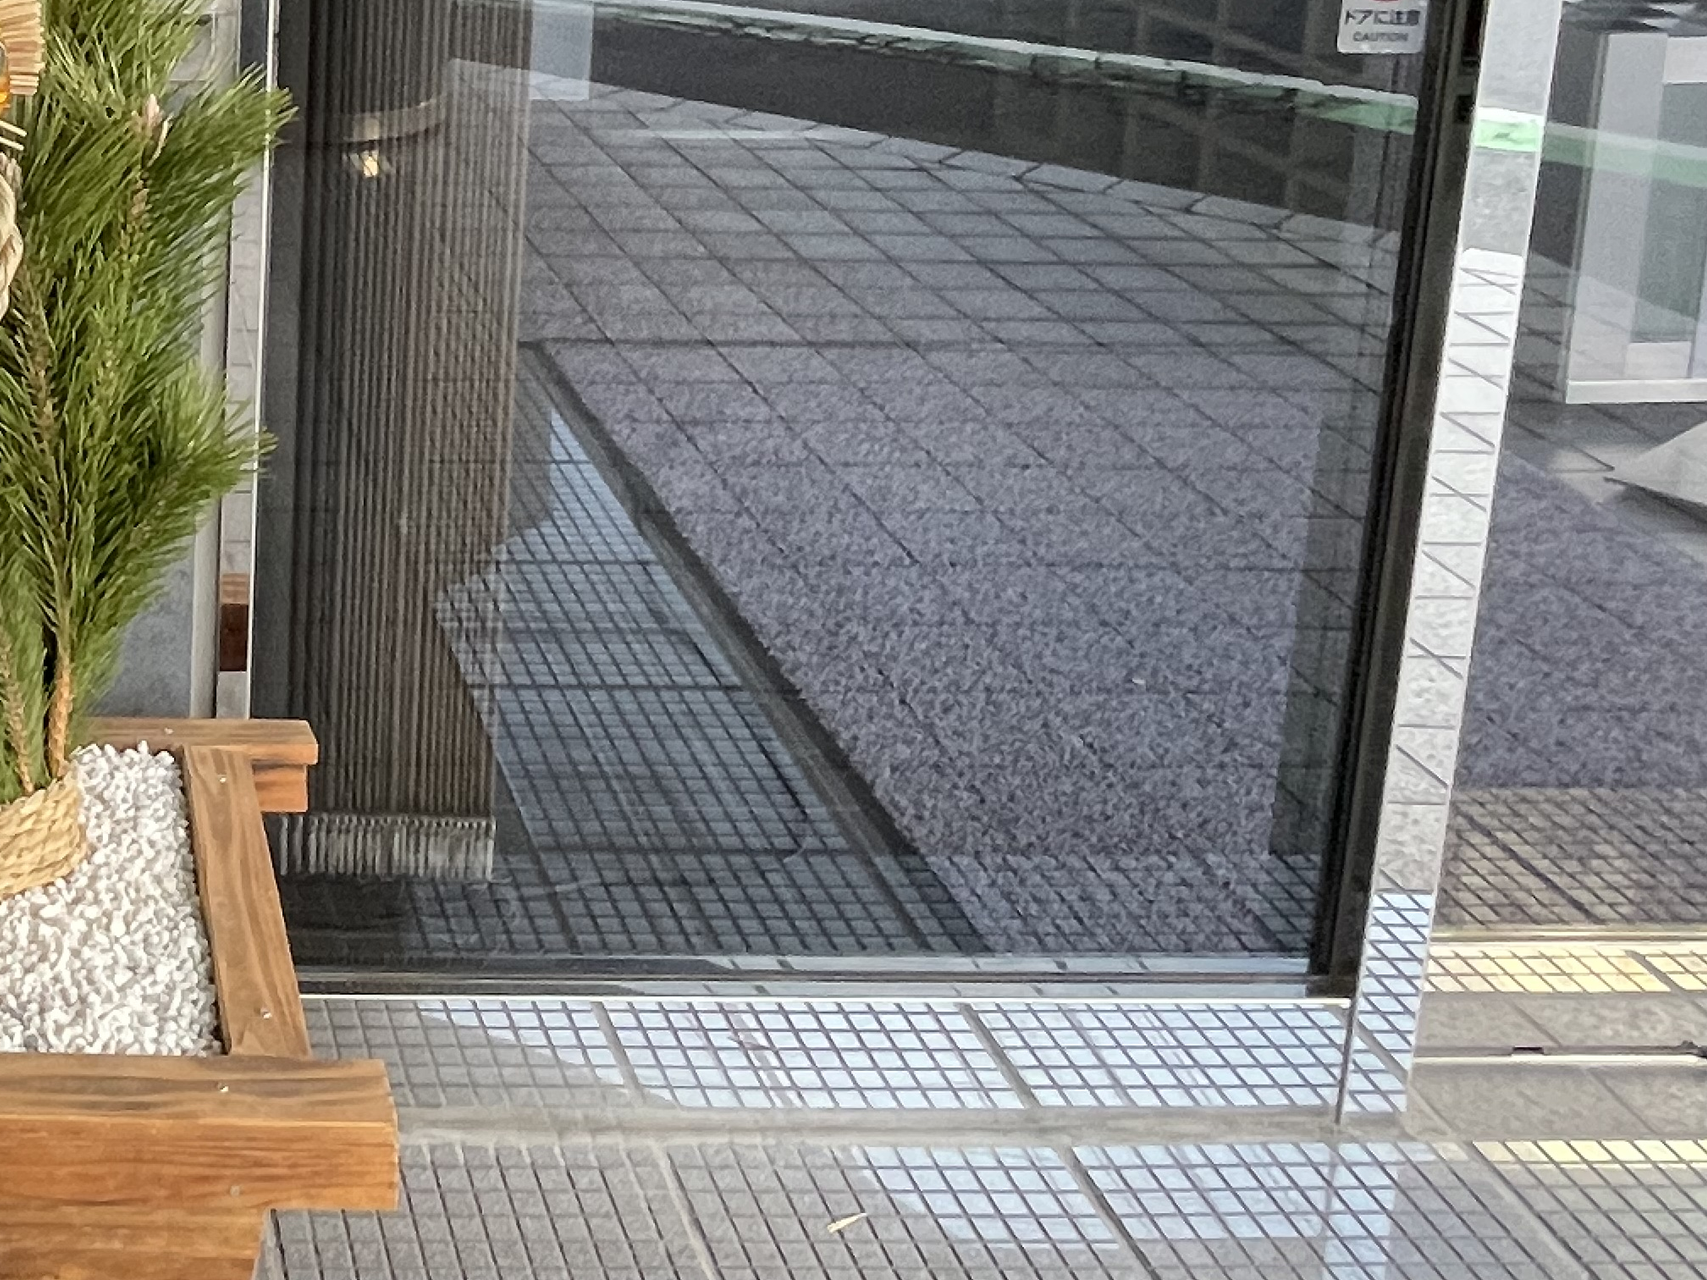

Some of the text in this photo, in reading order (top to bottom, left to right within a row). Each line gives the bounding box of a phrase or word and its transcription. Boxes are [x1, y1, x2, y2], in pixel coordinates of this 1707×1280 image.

[1344, 9, 1421, 26] ドアに注意
